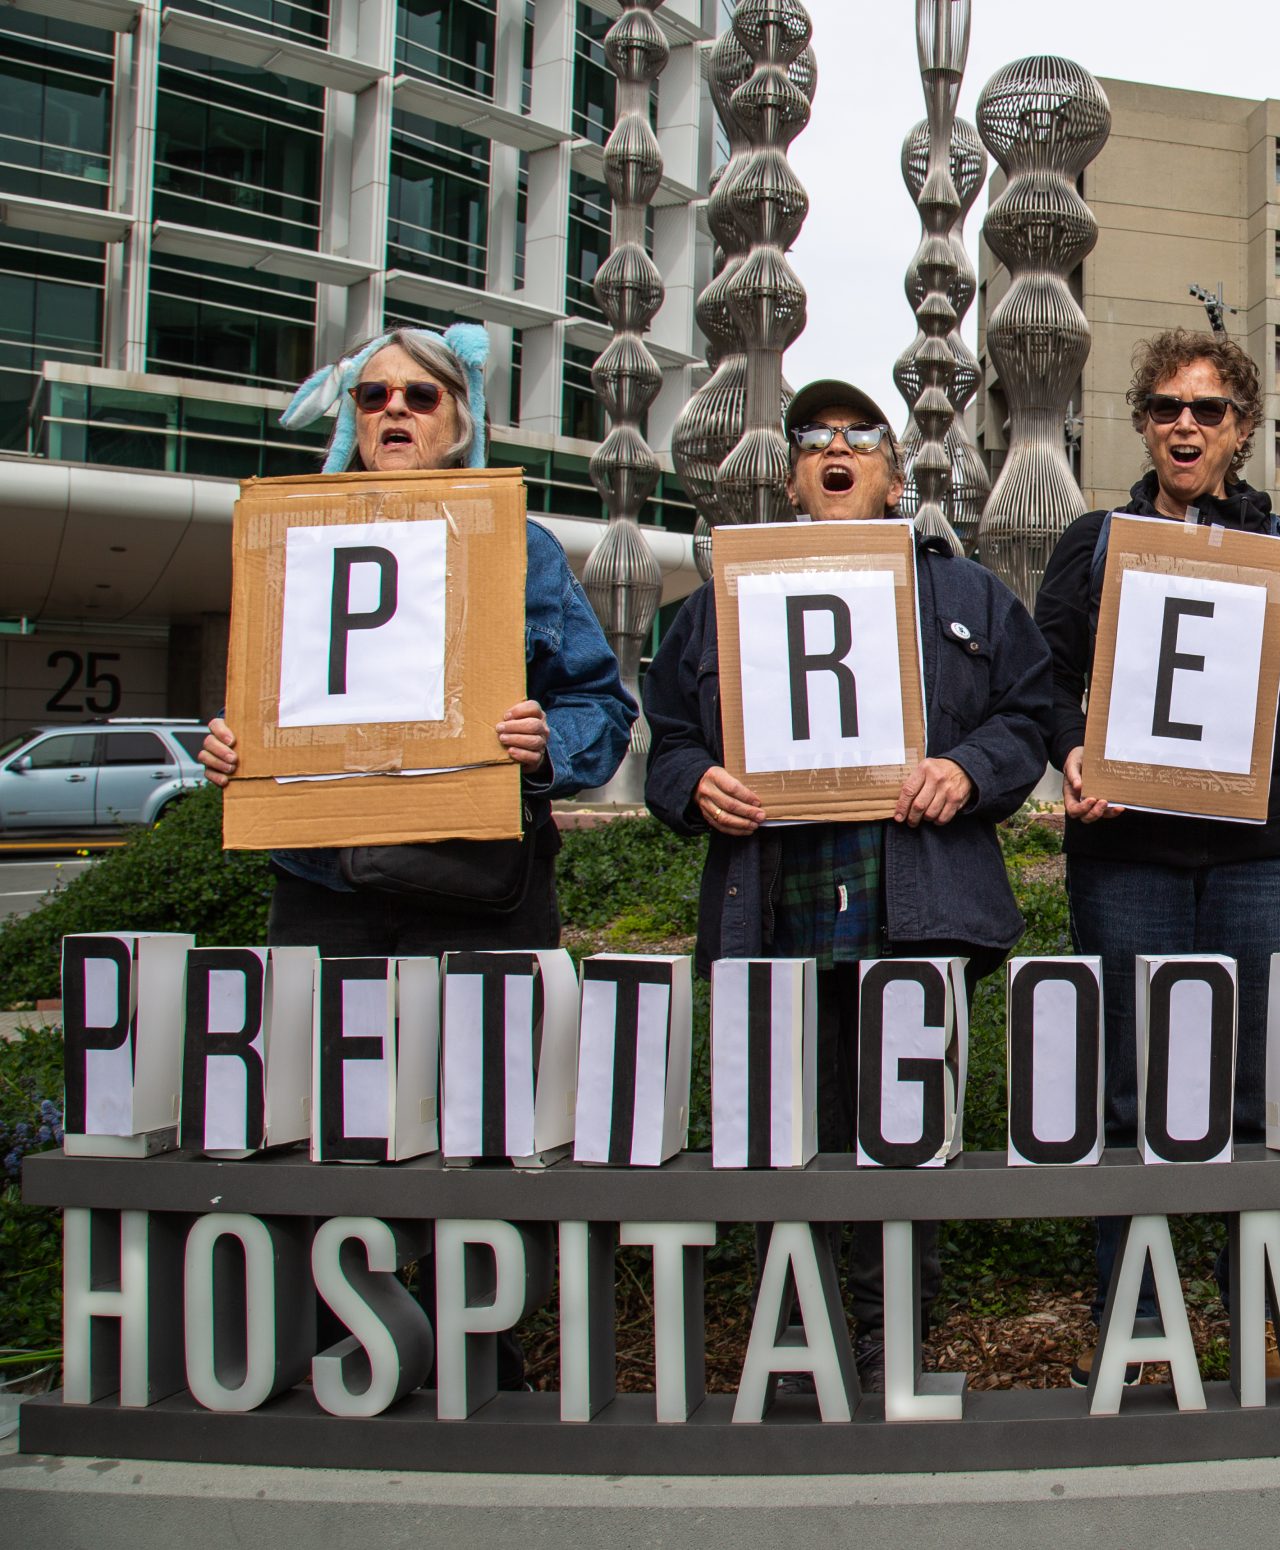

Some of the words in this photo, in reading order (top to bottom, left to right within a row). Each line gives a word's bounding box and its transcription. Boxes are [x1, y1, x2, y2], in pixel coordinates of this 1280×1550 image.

[46, 650, 121, 714] 25
[328, 545, 398, 696] P
[785, 593, 859, 741] R
[1151, 597, 1214, 741] E
[62, 1207, 963, 1424] HOSPITAL
